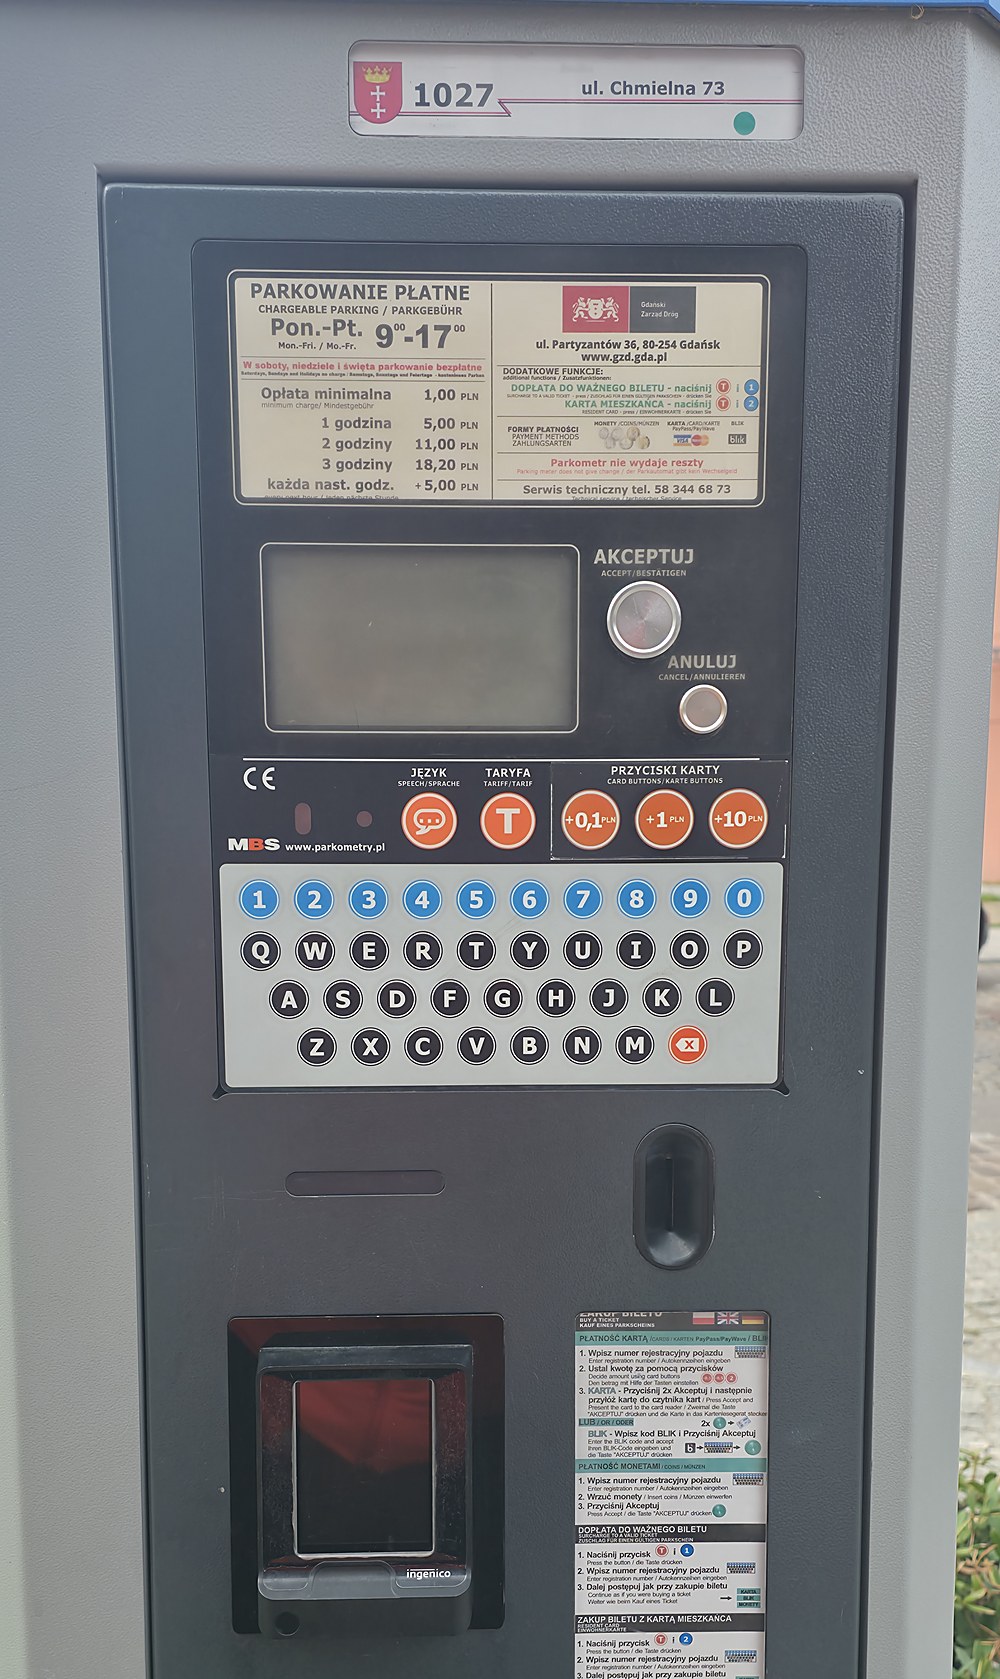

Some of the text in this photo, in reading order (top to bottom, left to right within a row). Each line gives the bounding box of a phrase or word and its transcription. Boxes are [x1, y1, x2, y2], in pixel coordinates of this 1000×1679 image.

[581, 81, 725, 96] ul. Chmielna 73
[414, 83, 494, 108] 1027
[251, 283, 470, 301] PARKOWANIE PŁATNE
[259, 305, 327, 314] CHARGEABLE
[330, 305, 379, 315] PARKING
[392, 305, 462, 315] PARKGEBÜHR
[271, 318, 363, 337] Pon.-Pt.
[278, 342, 316, 350] Mon.-Fri.
[326, 342, 356, 350] Mo.-Fr.
[536, 340, 720, 351] ul. Partyzantów 36, 80-254 Gdańsk
[581, 352, 667, 363] www.gzd.gda.pl
[255, 362, 289, 371] soboty,
[292, 362, 334, 370] niedziele
[344, 362, 375, 372] święta
[378, 363, 433, 372] parkowanie
[261, 387, 309, 402] Opłata
[315, 388, 391, 400] minimalna
[424, 389, 455, 402] 1,00
[322, 418, 329, 428] 1
[335, 418, 391, 431] godzina
[424, 418, 455, 431] 5,00
[537, 425, 579, 433] PŁATNOŚCI
[322, 438, 478, 452] 2 godziny 11,00 PLN
[730, 435, 745, 444] blik
[322, 459, 330, 469] 3
[336, 459, 392, 472] godziny
[416, 459, 455, 472] 18,20
[551, 458, 703, 468] Parkometr nie wydaje reszty
[268, 479, 309, 490] każda
[315, 480, 350, 490] nast.
[356, 480, 394, 493] godz.
[461, 483, 478, 491] PLN
[523, 484, 731, 495] Serwis techniczny tel. 58 344 68 73
[594, 549, 694, 564] AKCEPTUJ
[668, 655, 736, 669] ANULUJ
[658, 673, 746, 681] CANCEL/ANNULIEREN
[411, 767, 447, 780] JĘZYK
[485, 768, 531, 778] TARYFA
[611, 765, 720, 776] PRZYCISKI KARTY
[243, 767, 276, 790] CE
[496, 808, 520, 834] T
[228, 838, 280, 851] MBS
[285, 842, 385, 852] www.parkometry.pl
[253, 889, 751, 908] 1 2 3 4 5 6 7 8 9 0
[251, 941, 751, 963] Q W E R T Y U I O P
[280, 989, 722, 1009] A S D F G H J K L
[580, 1334, 648, 1343] PŁATNOŚĆ KARTĄ
[633, 1525, 676, 1533] WAŻNEGO
[407, 1568, 450, 1580] ingenico
[647, 1616, 675, 1624] KARTĄ
[678, 1614, 732, 1622] MIESZKAŃCA
